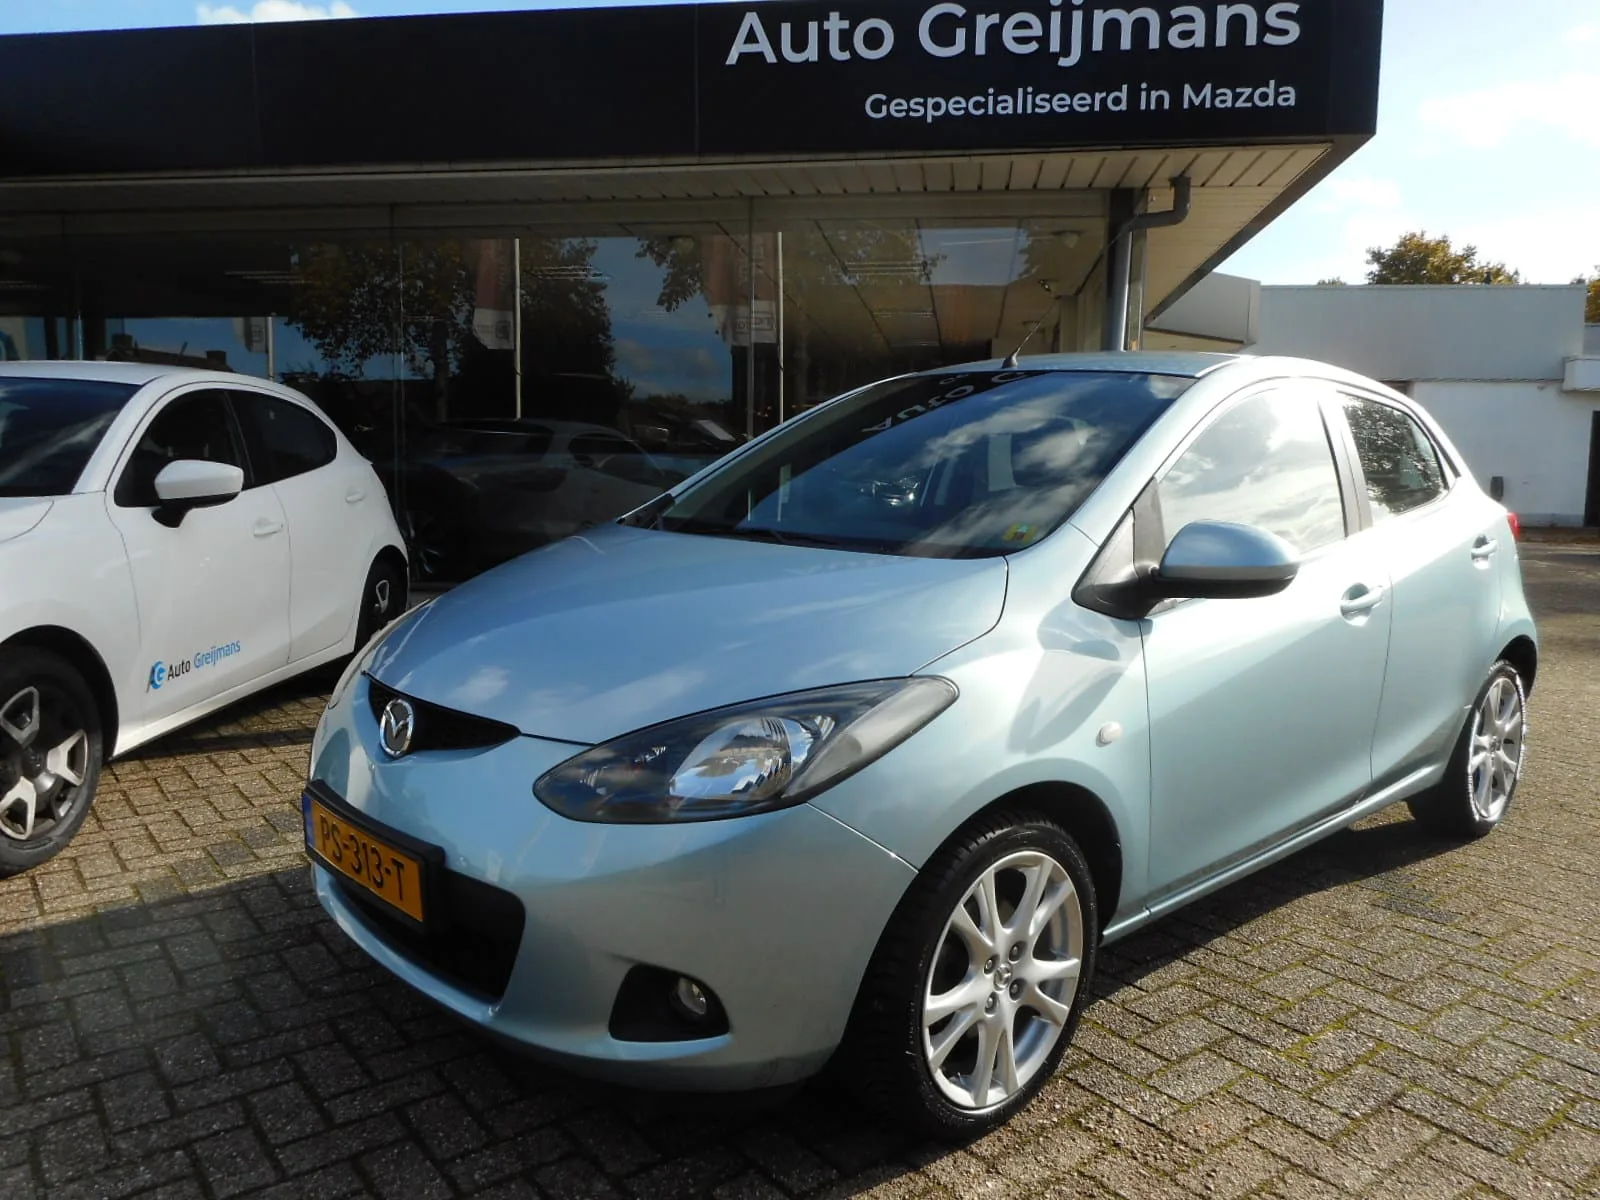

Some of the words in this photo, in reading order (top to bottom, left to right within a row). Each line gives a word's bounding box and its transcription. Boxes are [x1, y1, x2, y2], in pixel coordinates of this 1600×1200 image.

[725, 11, 894, 65] Auto
[918, 0, 1301, 67] Greijmans
[864, 83, 1128, 123] Gespecialiseerd
[1139, 82, 1170, 111] in
[1182, 80, 1297, 110] Mazda
[167, 659, 191, 681] Auto
[193, 640, 240, 668] Greijmans
[319, 812, 405, 901] PS-313-T
